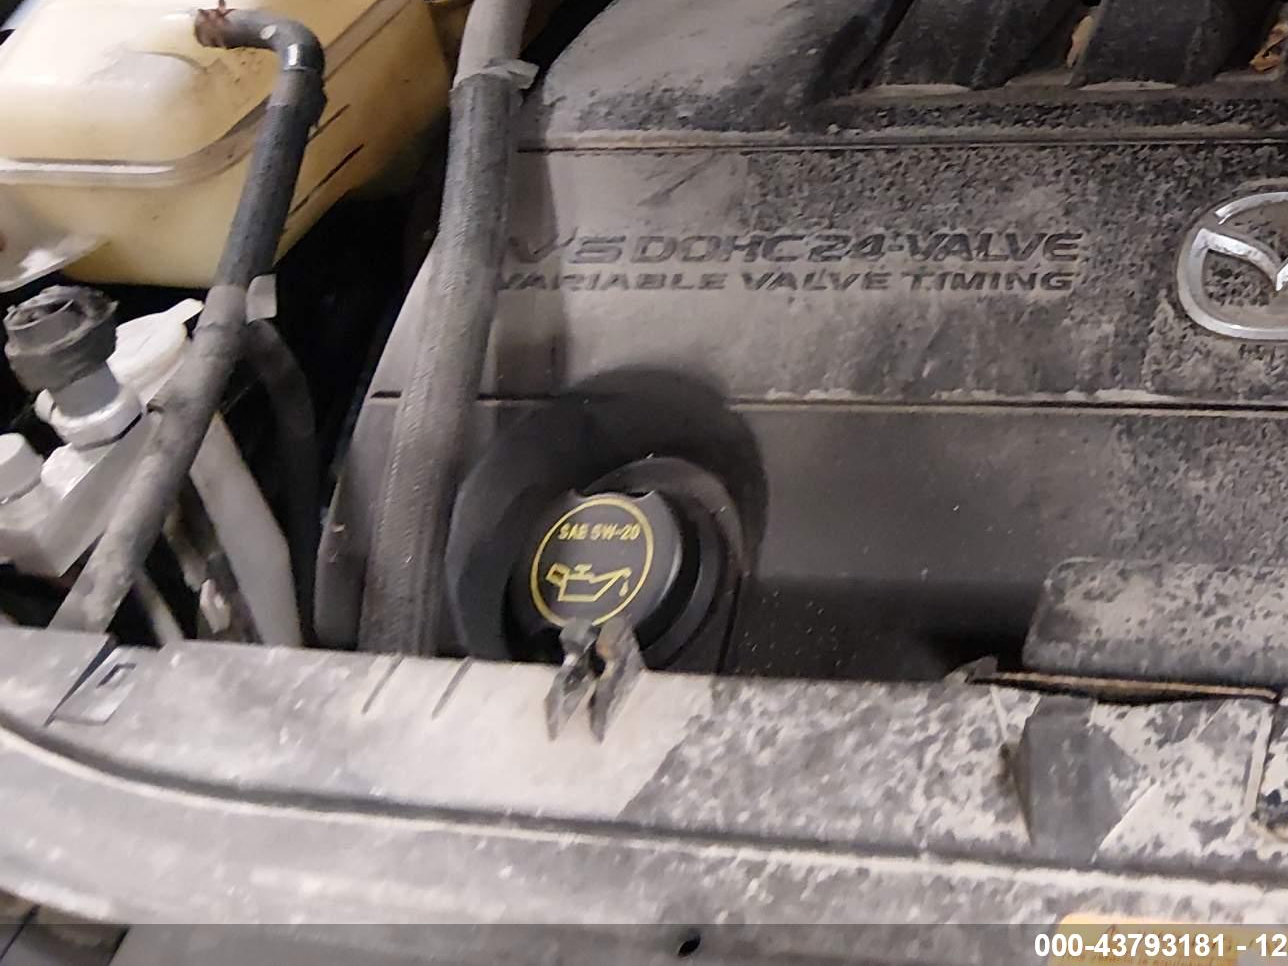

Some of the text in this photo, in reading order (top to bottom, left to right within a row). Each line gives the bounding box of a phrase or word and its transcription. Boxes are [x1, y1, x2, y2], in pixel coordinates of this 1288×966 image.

[629, 234, 804, 263] DOHC
[807, 232, 1084, 262] 24-VALVE
[496, 271, 1079, 292] VARIABLE VALVE TIMING
[558, 522, 640, 540] SAE 5W-20
